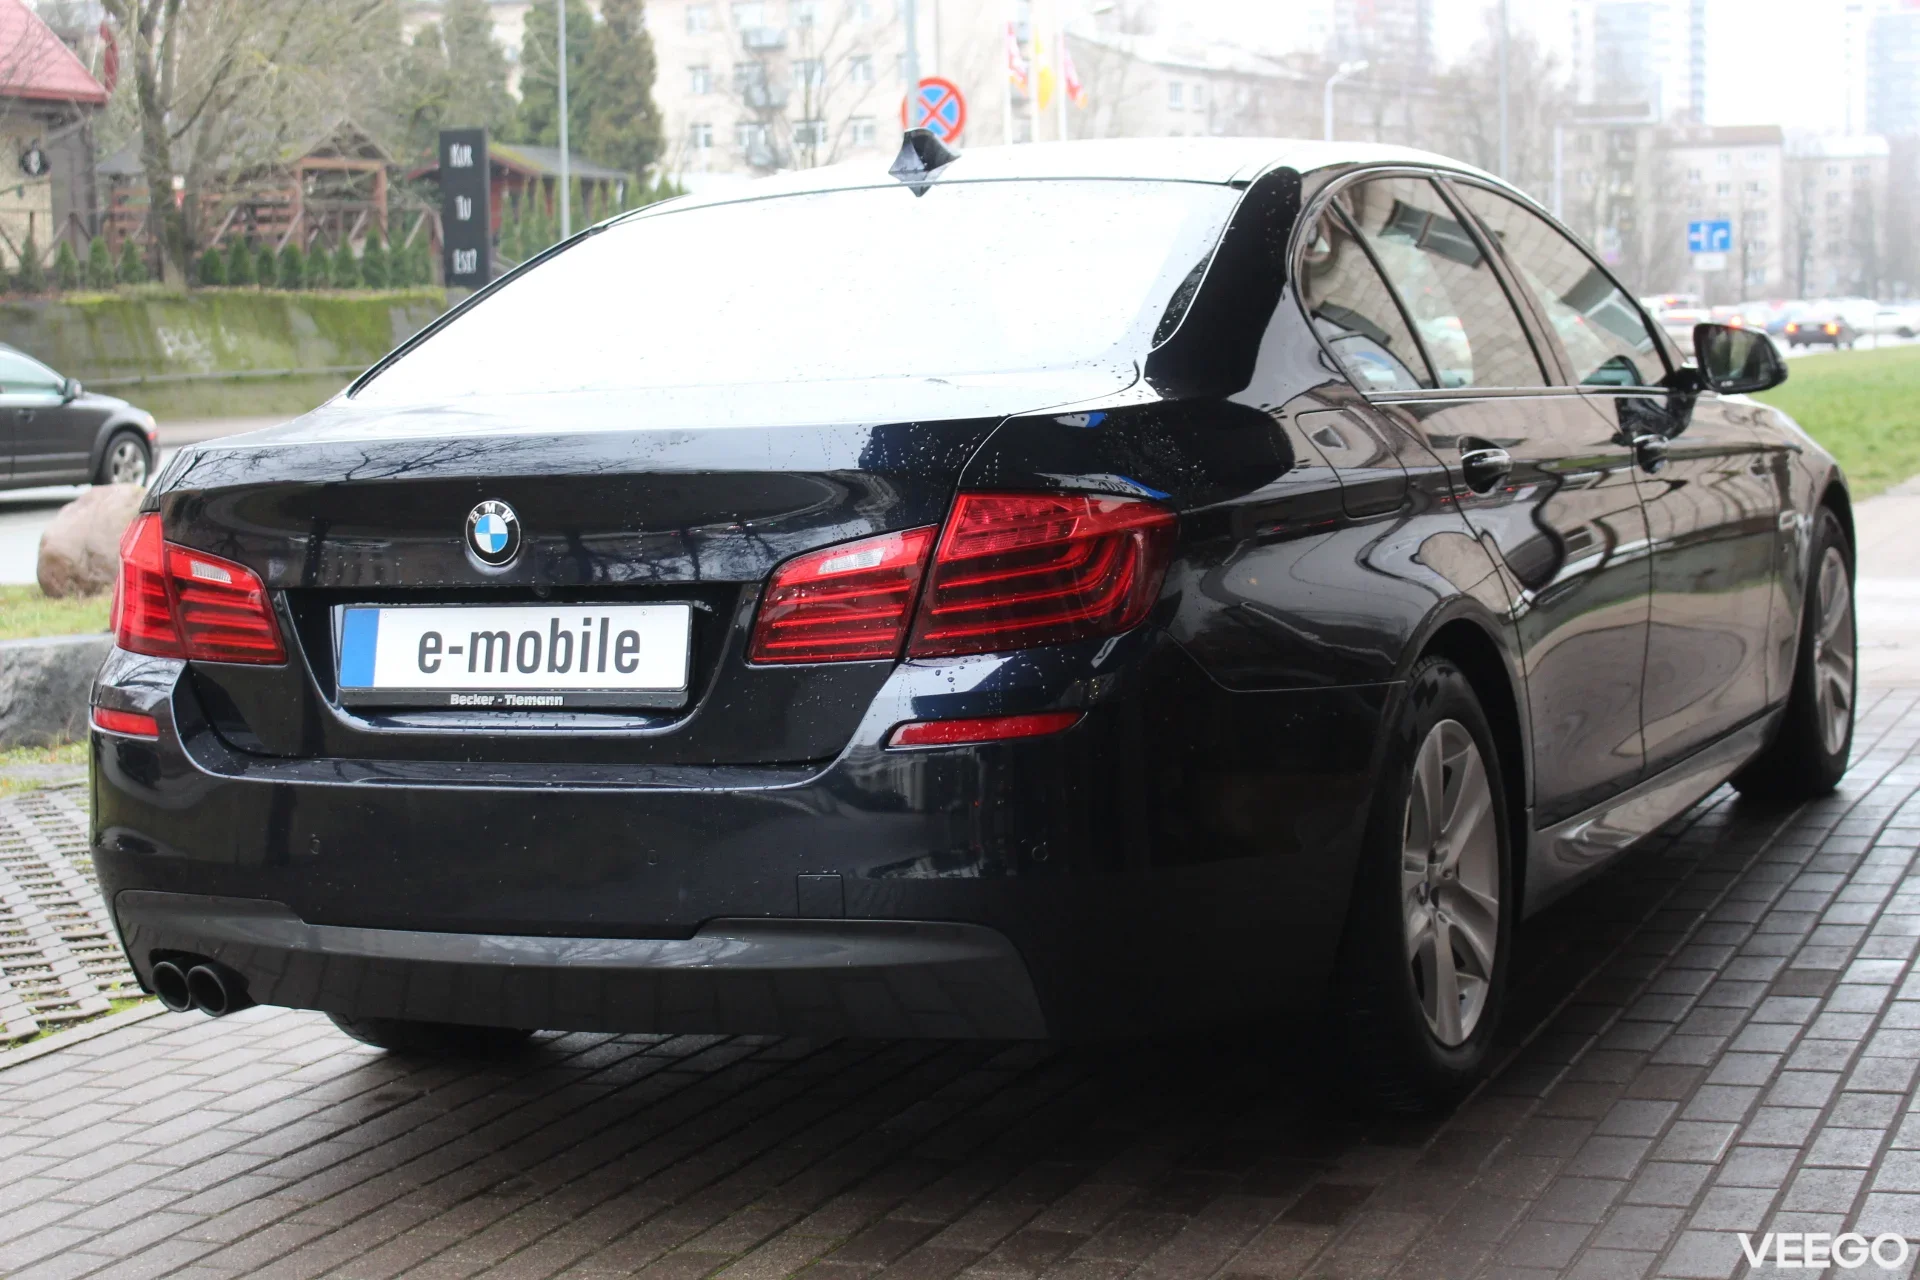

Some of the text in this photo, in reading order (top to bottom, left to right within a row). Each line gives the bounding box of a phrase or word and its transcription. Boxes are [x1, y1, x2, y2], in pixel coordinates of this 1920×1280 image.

[470, 503, 515, 523] BMW
[418, 617, 641, 674] e-mobile
[450, 694, 495, 705] Becker
[505, 694, 564, 706] Tiemann
